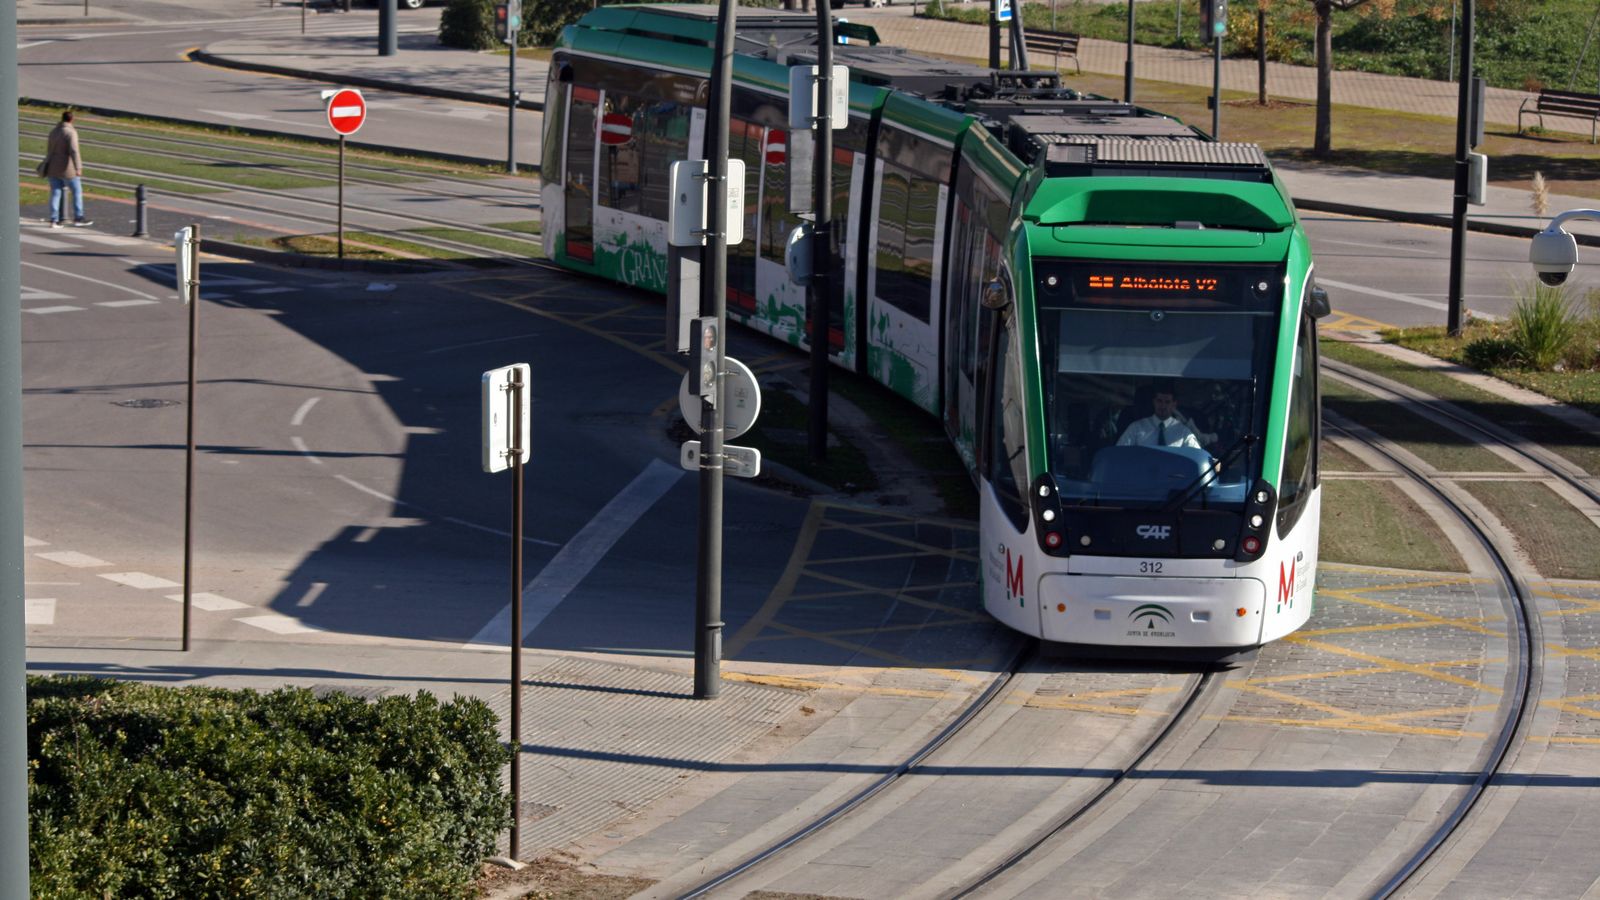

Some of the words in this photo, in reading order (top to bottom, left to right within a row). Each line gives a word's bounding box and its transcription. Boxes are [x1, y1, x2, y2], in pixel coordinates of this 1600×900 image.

[1120, 276, 1191, 289] Albolote
[1195, 278, 1217, 291] V2
[1136, 524, 1171, 539] CAF
[1140, 561, 1163, 573] 312
[1006, 547, 1024, 608] M
[1277, 556, 1295, 613] M
